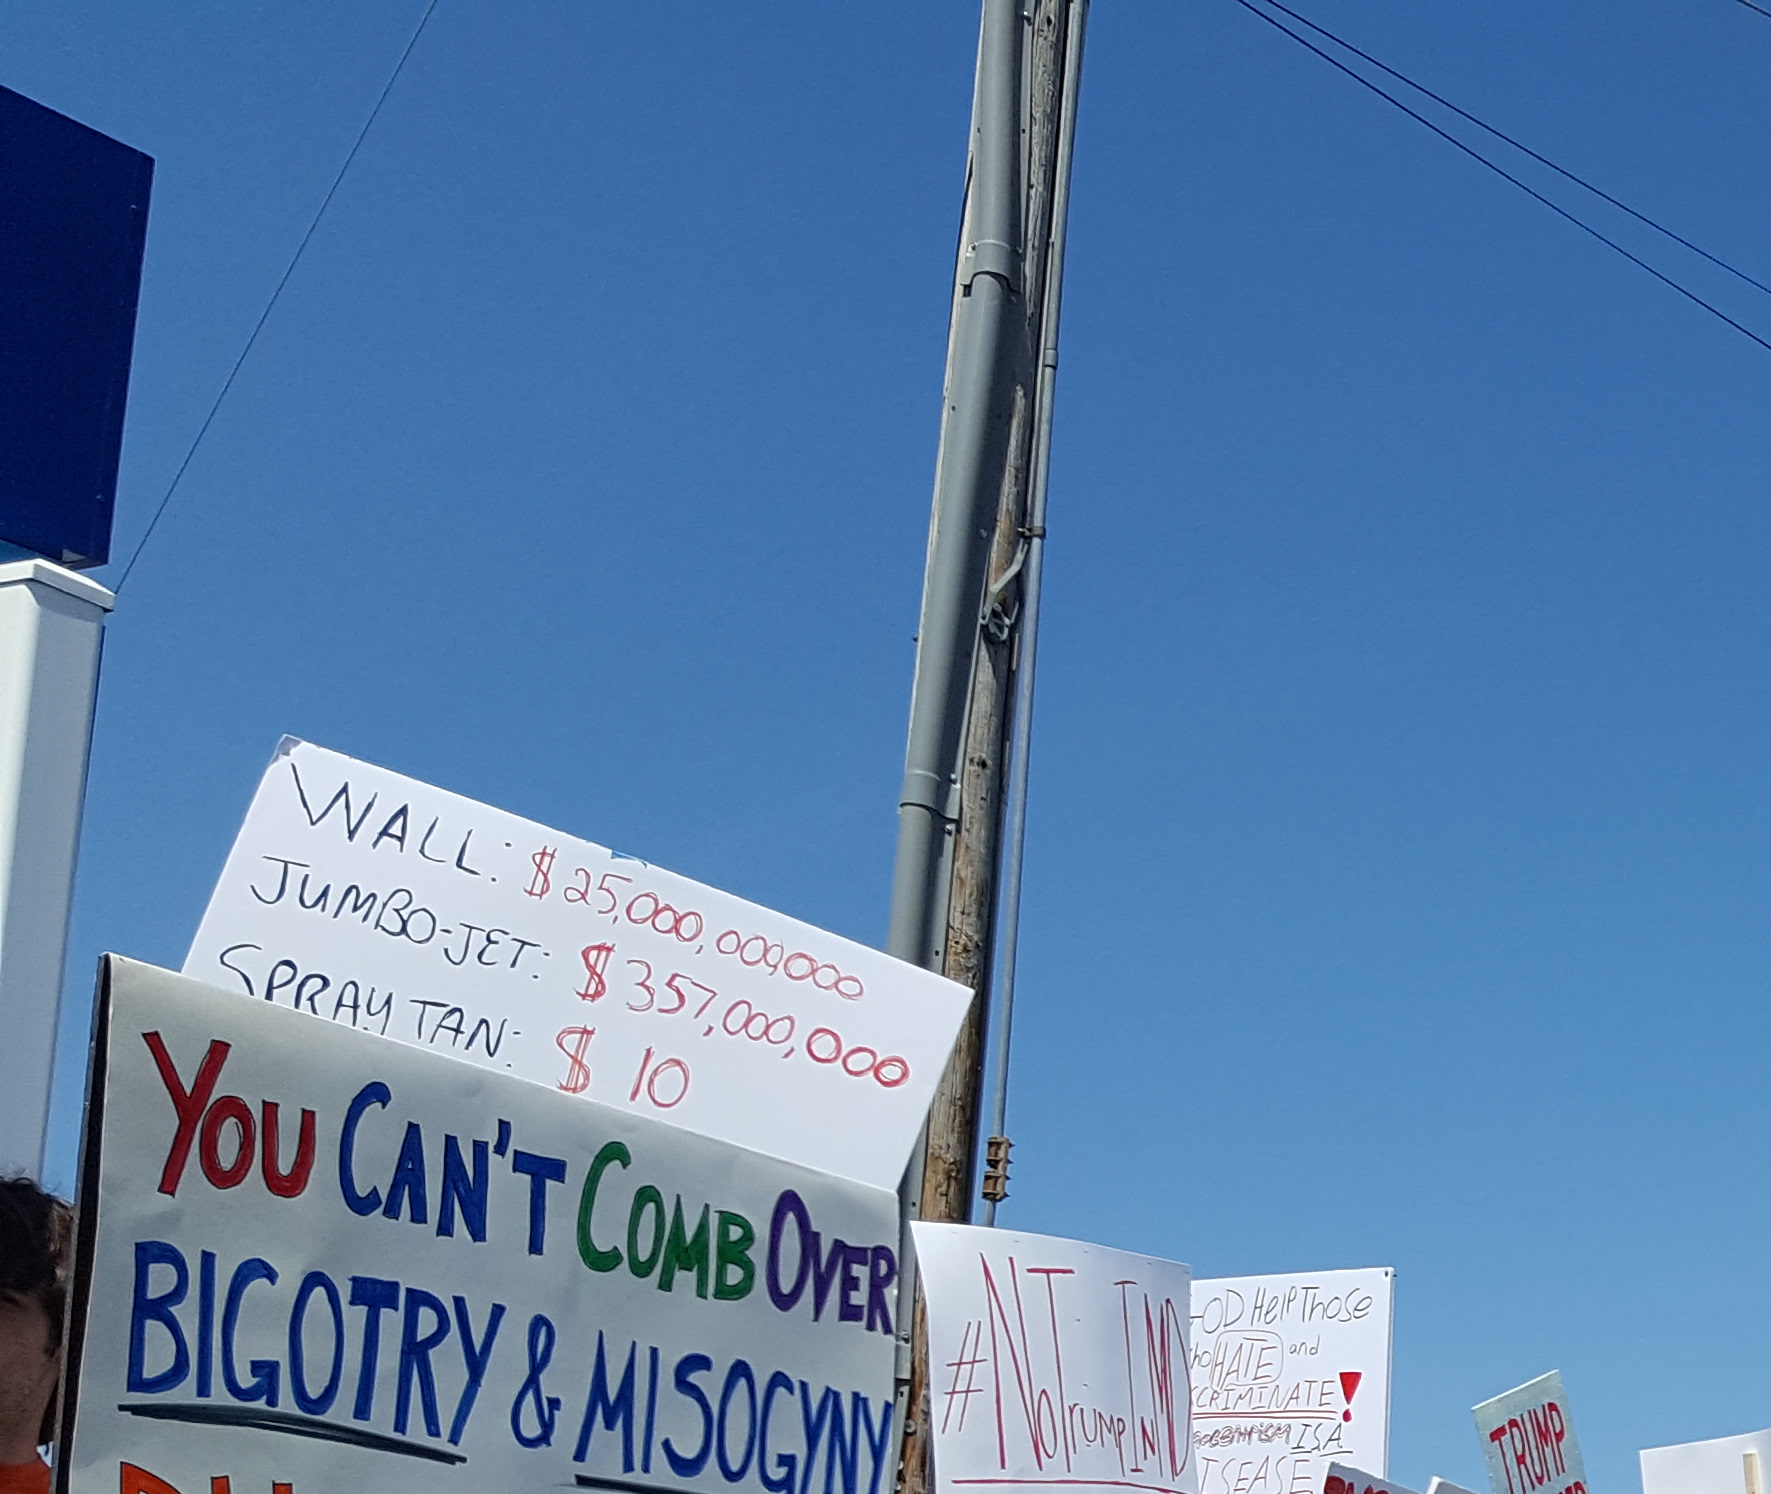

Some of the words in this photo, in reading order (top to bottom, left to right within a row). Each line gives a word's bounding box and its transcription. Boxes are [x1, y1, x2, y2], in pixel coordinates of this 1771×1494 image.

[291, 762, 512, 883] WALL:
[250, 855, 550, 979] JUMBO-JET:
[219, 943, 394, 1036] SPRAY
[409, 999, 522, 1067] TAN:
[340, 1081, 567, 1256] CAN'T
[576, 1141, 757, 1302] COMB
[765, 1190, 898, 1335] OVER
[127, 1240, 505, 1446] BIGOTRY
[511, 1314, 562, 1450] &
[1190, 1340, 1212, 1370] ho
[1211, 1336, 1278, 1391] HATE
[1289, 1335, 1321, 1356] and
